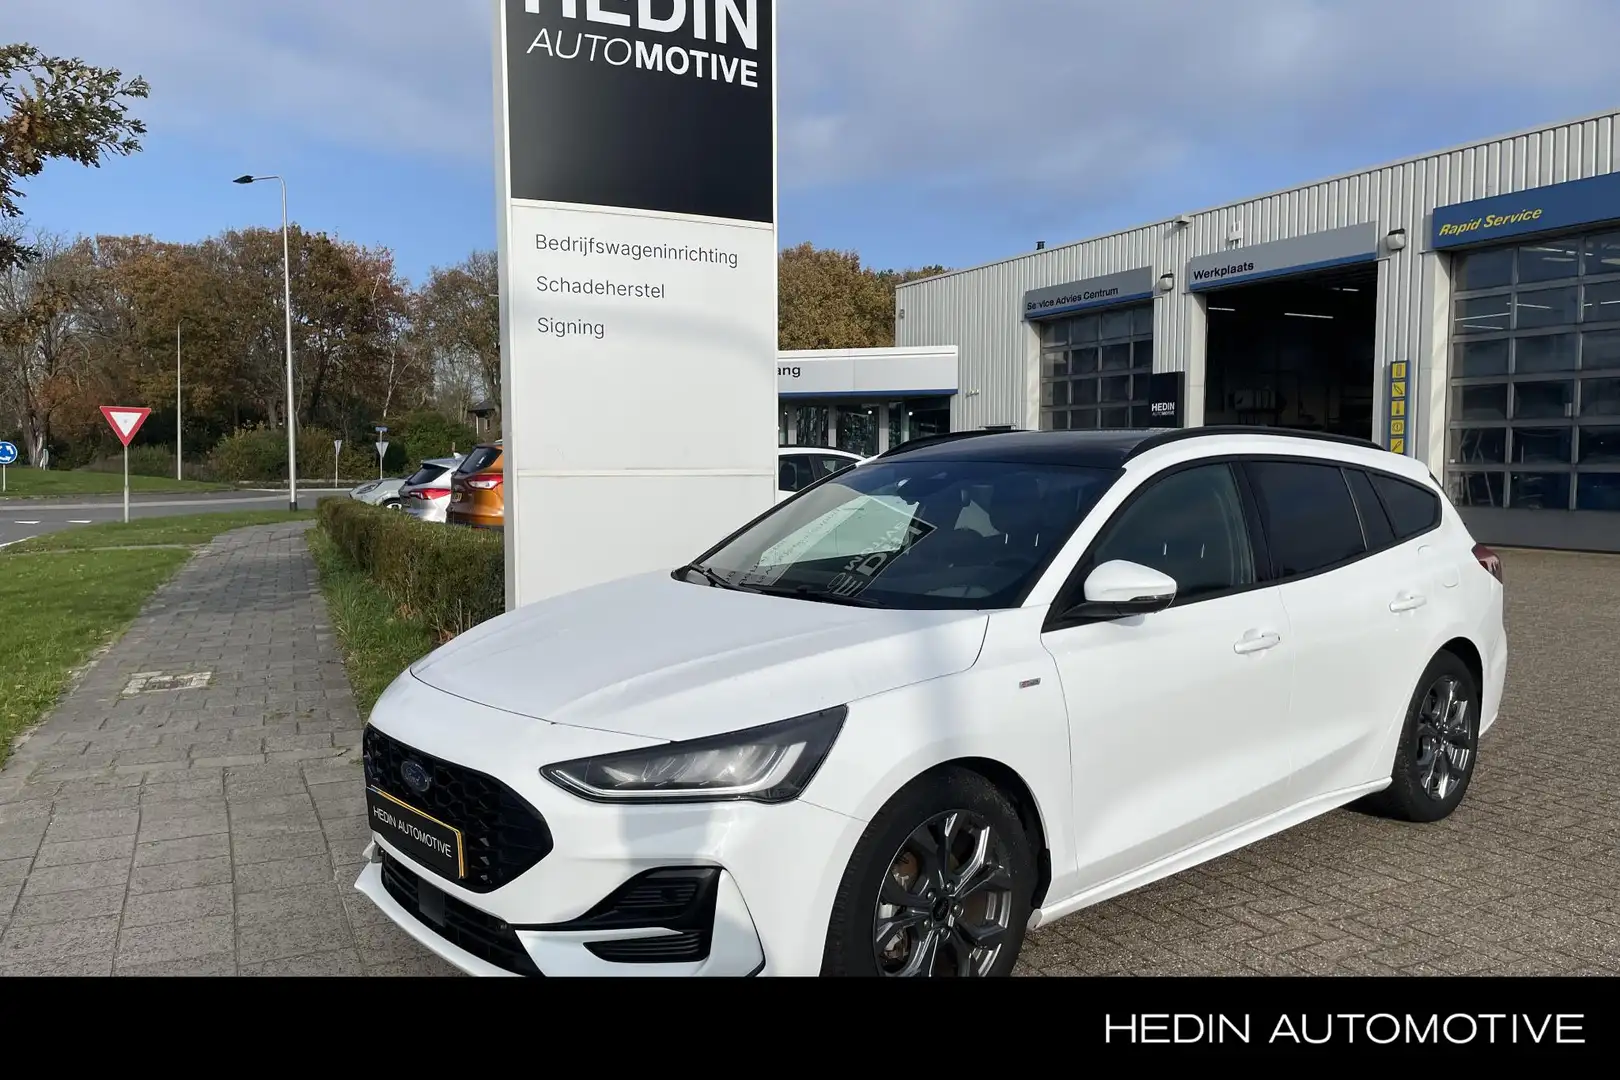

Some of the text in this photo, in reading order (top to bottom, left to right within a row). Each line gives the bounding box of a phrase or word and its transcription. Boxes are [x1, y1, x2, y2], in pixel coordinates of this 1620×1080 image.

[525, 0, 758, 50] DIN
[526, 28, 758, 88] AUTOMOTIVE
[1439, 208, 1542, 236] Rapid Service
[535, 233, 739, 268] Bedrijfswageninrichting
[1193, 262, 1254, 280] Werkplaats
[536, 275, 665, 299] Schadeherstel
[1027, 287, 1119, 311] Sevice Advies Centrum
[537, 317, 605, 340] Signing
[1151, 401, 1175, 412] HEDIN
[372, 804, 453, 858] HEDIN AUTOMOTIVE
